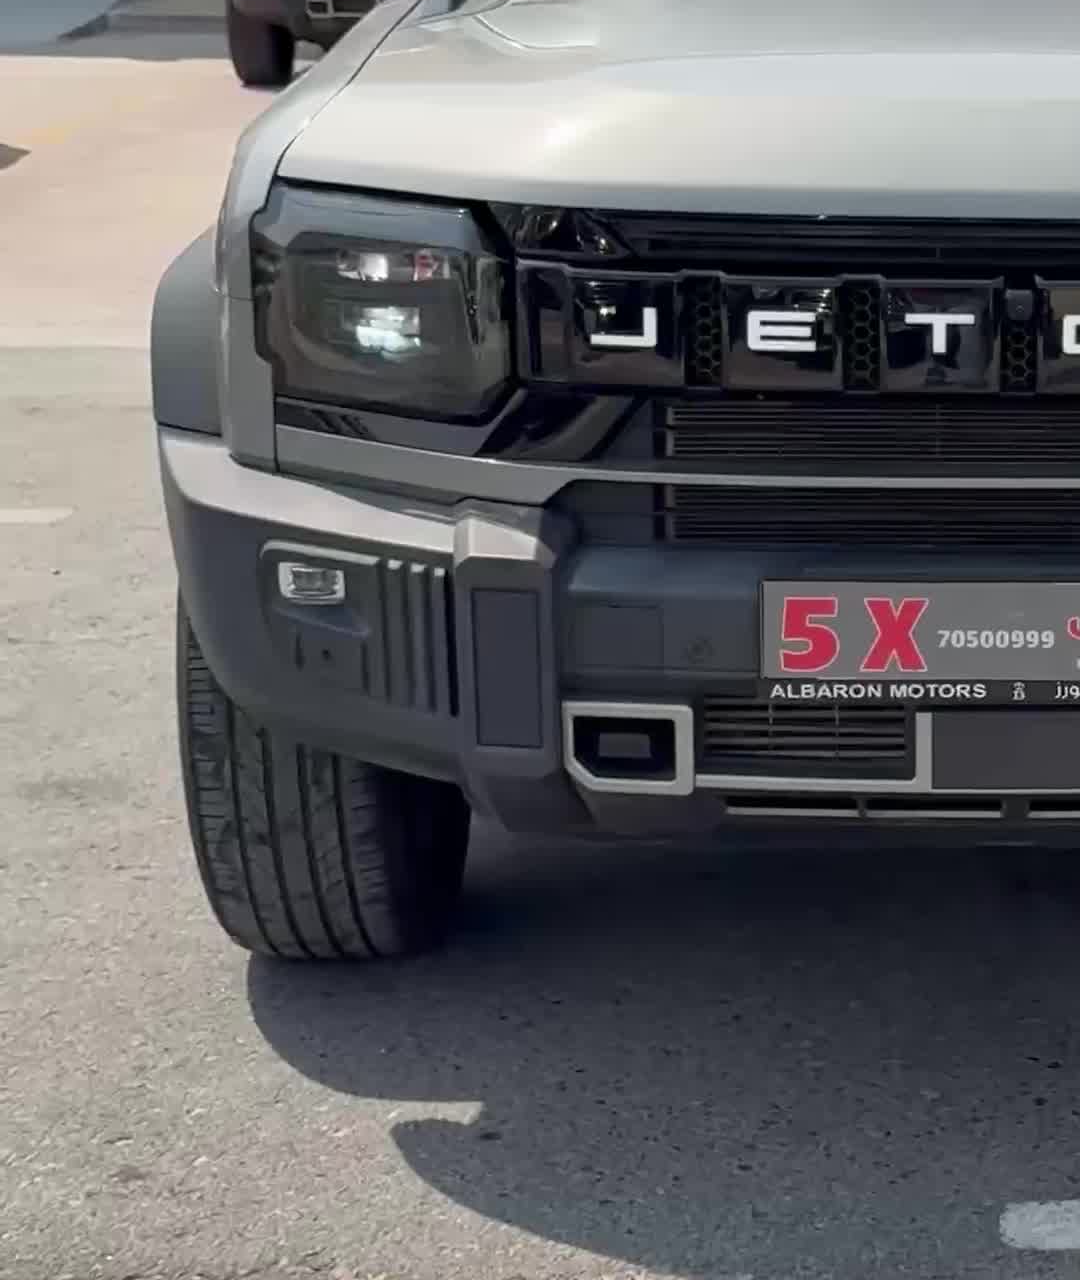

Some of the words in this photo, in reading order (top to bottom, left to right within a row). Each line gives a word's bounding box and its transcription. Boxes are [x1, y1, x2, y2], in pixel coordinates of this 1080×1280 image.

[780, 596, 840, 672] 5
[859, 597, 929, 672] X
[937, 629, 1055, 649] 70500999
[770, 683, 882, 699] ALBARON
[890, 683, 988, 699] MOTORS
